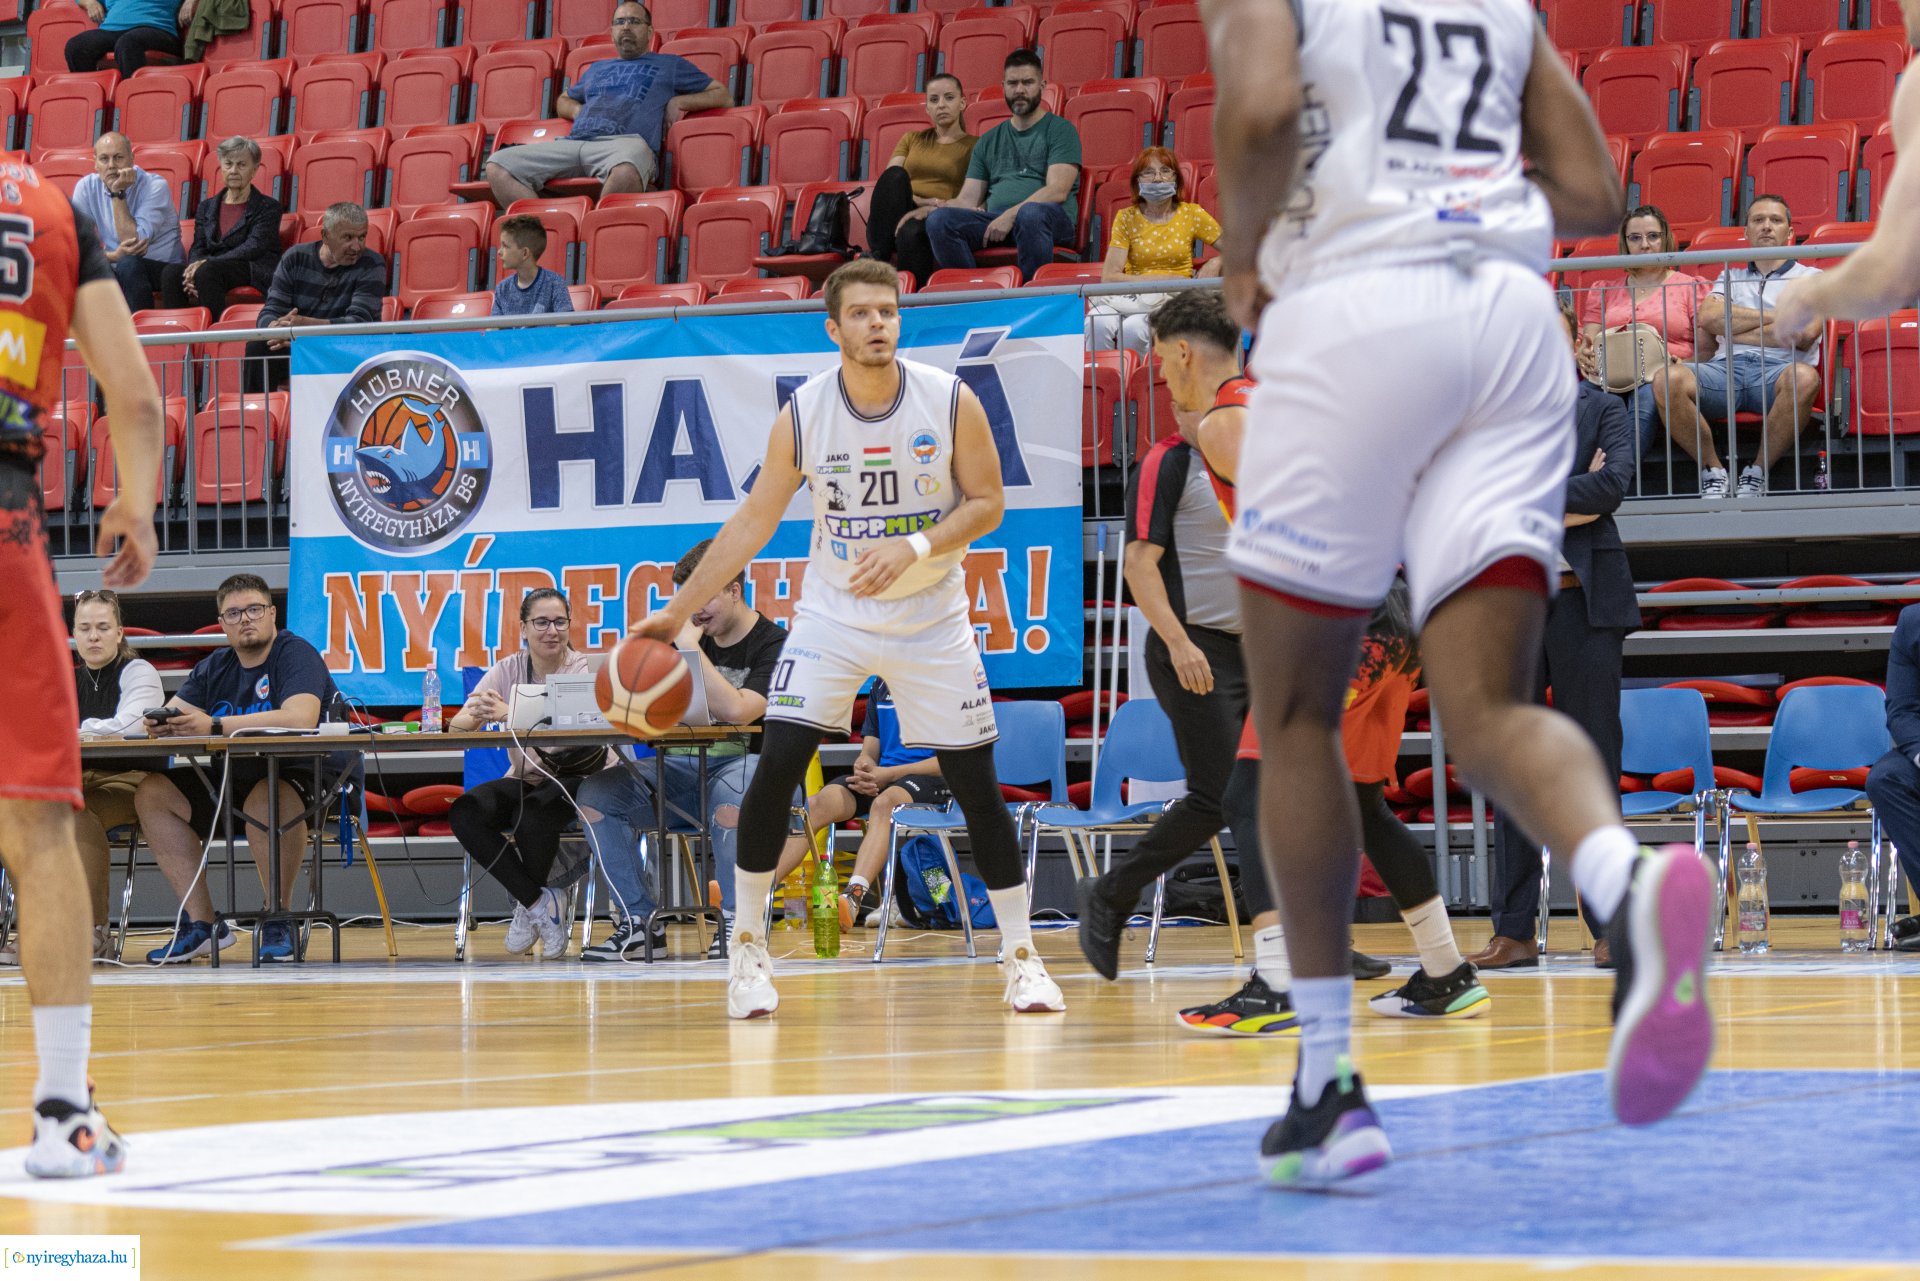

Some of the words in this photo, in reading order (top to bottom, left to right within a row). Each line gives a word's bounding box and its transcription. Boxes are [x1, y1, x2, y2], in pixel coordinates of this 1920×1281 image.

[1380, 6, 1503, 154] 22
[351, 368, 461, 415] HÜBNER
[826, 453, 850, 463] JAKO
[338, 477, 461, 539] NYÍREGYHÁZA
[455, 474, 478, 503] BS
[860, 471, 899, 506] 20
